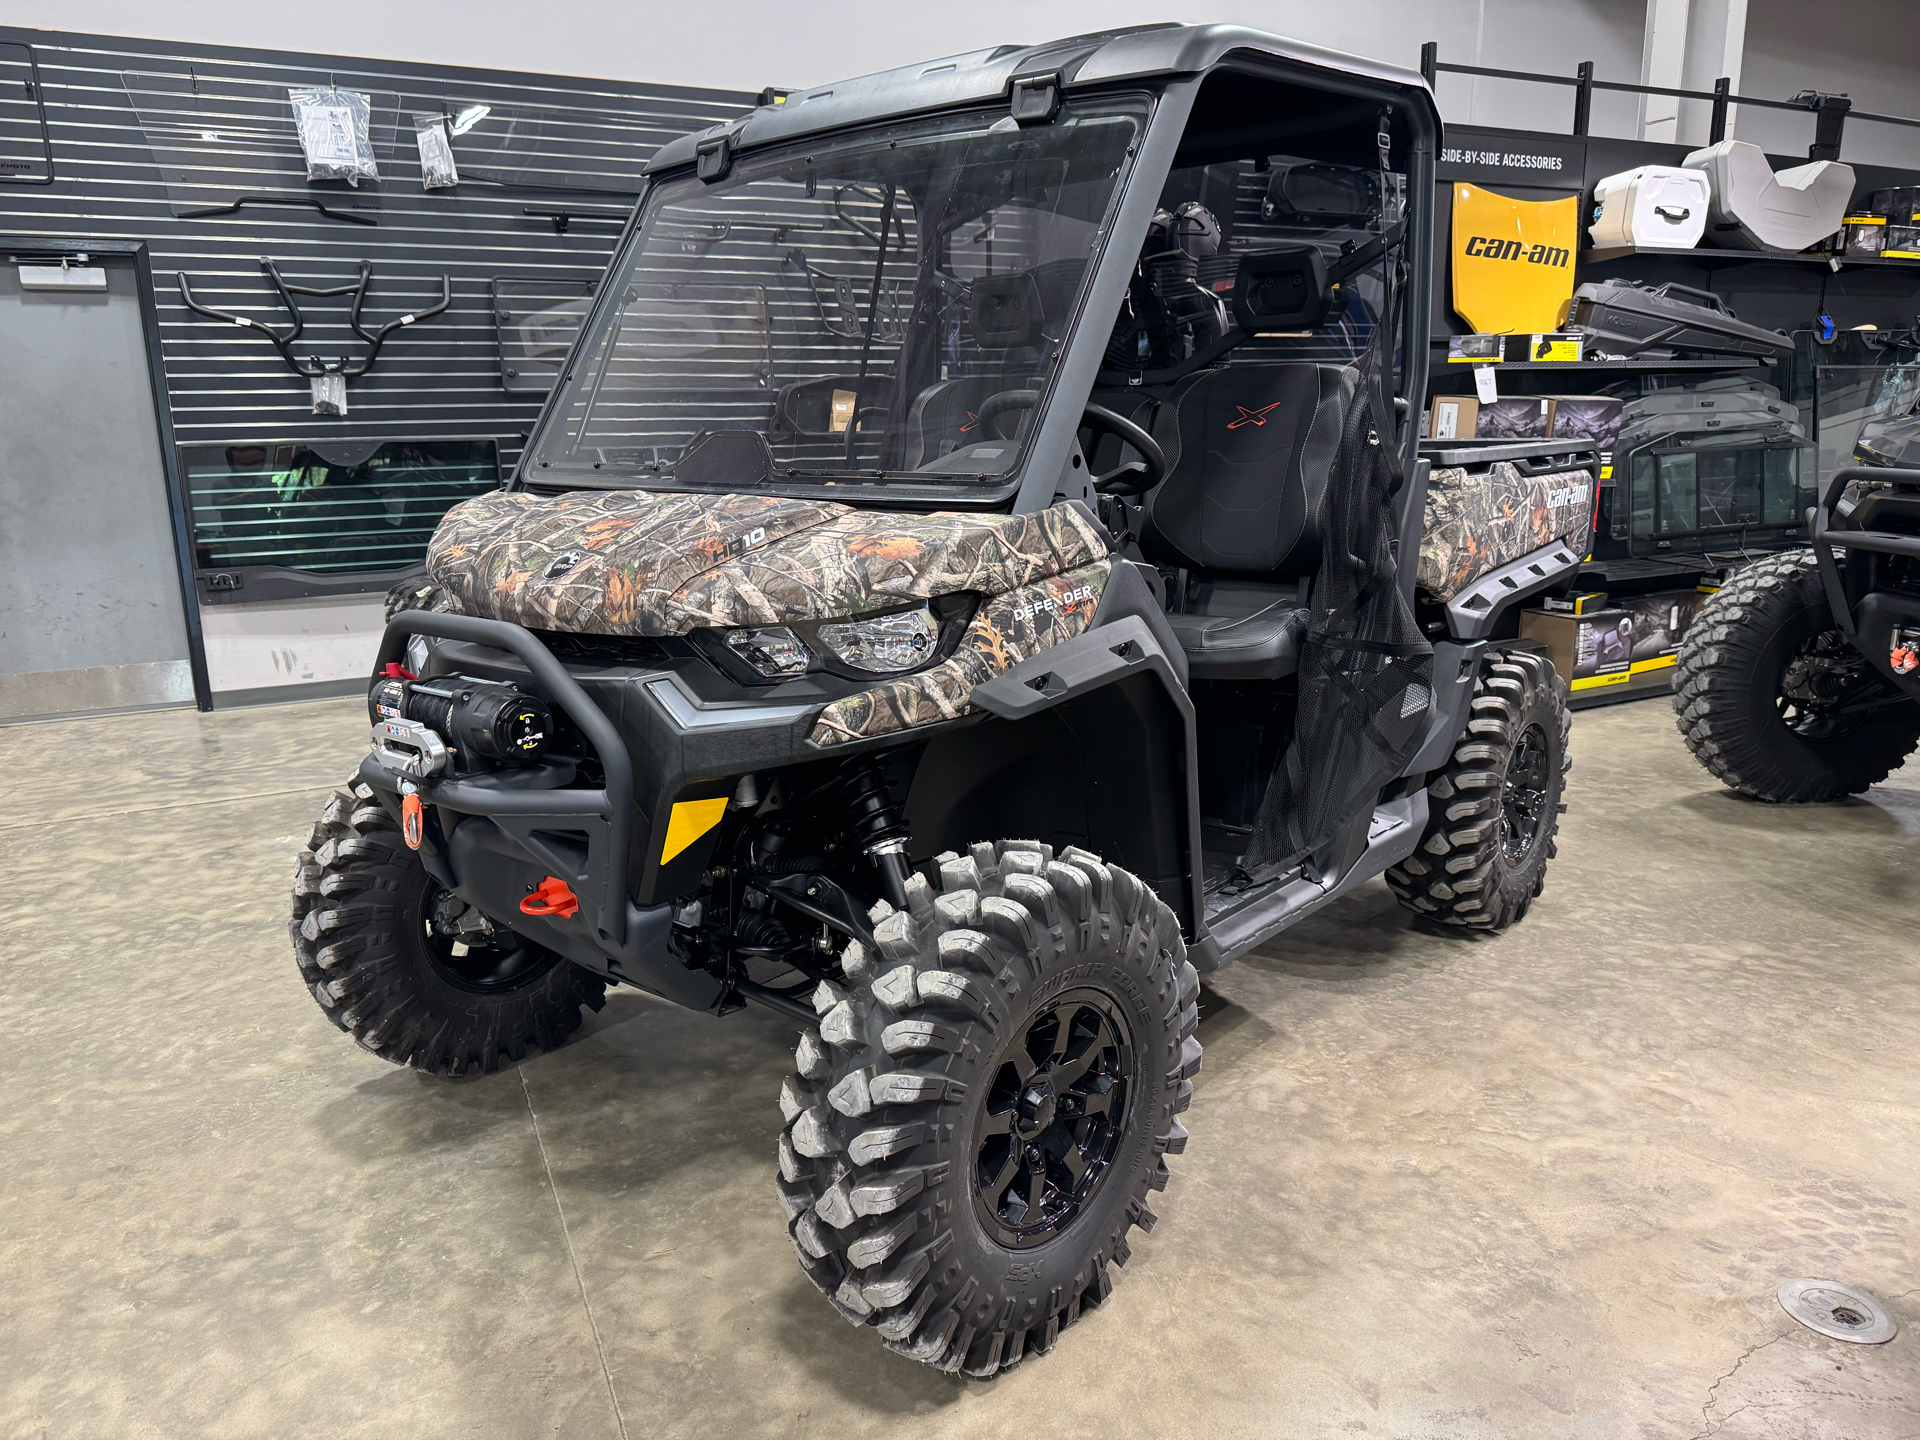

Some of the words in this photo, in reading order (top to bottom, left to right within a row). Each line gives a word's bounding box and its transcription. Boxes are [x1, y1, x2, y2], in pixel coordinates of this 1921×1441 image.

[1441, 148, 1500, 166] SIDE-BY-SIDE
[1502, 153, 1563, 171] ACCESSORIES
[1465, 236, 1570, 268] can-am
[1547, 484, 1590, 509] can-am
[712, 526, 766, 564] HD10
[553, 562, 575, 571] BRP
[1013, 585, 1092, 621] DEFENDER
[1027, 962, 1107, 1010] SWAMP
[1106, 965, 1152, 1026] FORCE
